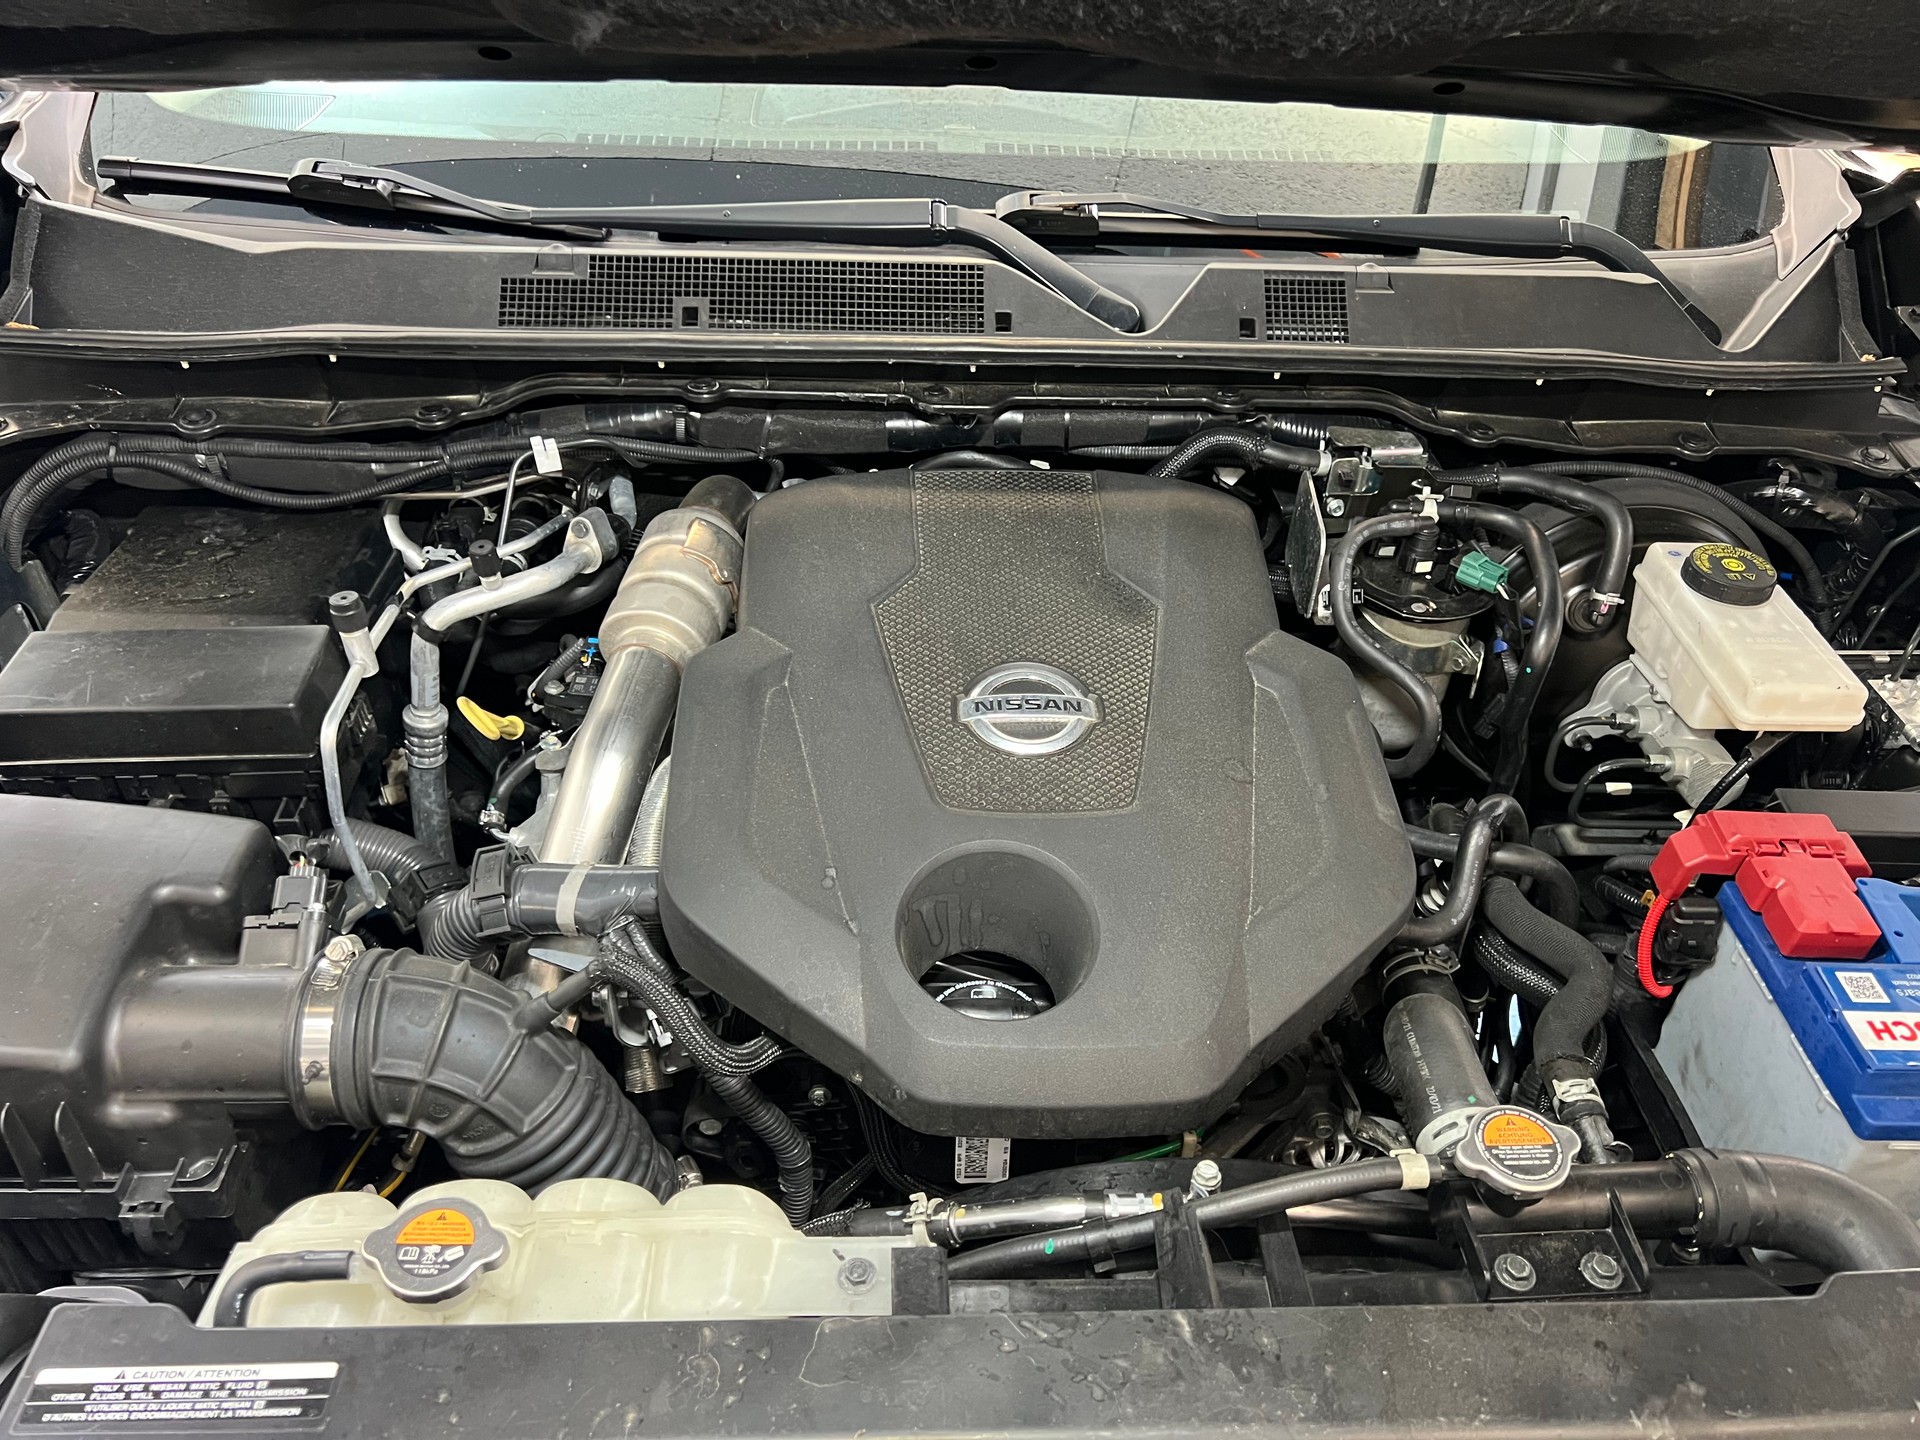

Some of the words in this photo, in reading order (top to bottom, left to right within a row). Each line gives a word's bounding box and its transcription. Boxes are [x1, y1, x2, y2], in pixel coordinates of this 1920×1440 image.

[974, 698, 1082, 712] NISSAN
[92, 1384, 120, 1392] ONLY
[148, 1383, 187, 1391] NISSAN
[189, 1382, 221, 1390] MATIC
[225, 1381, 255, 1389] FLUID
[51, 1393, 86, 1401] OTHER
[89, 1392, 126, 1400] FLUIDS
[160, 1390, 203, 1399] DAMAGE
[208, 1390, 232, 1398] THE
[235, 1387, 309, 1397] TRANSMISSION
